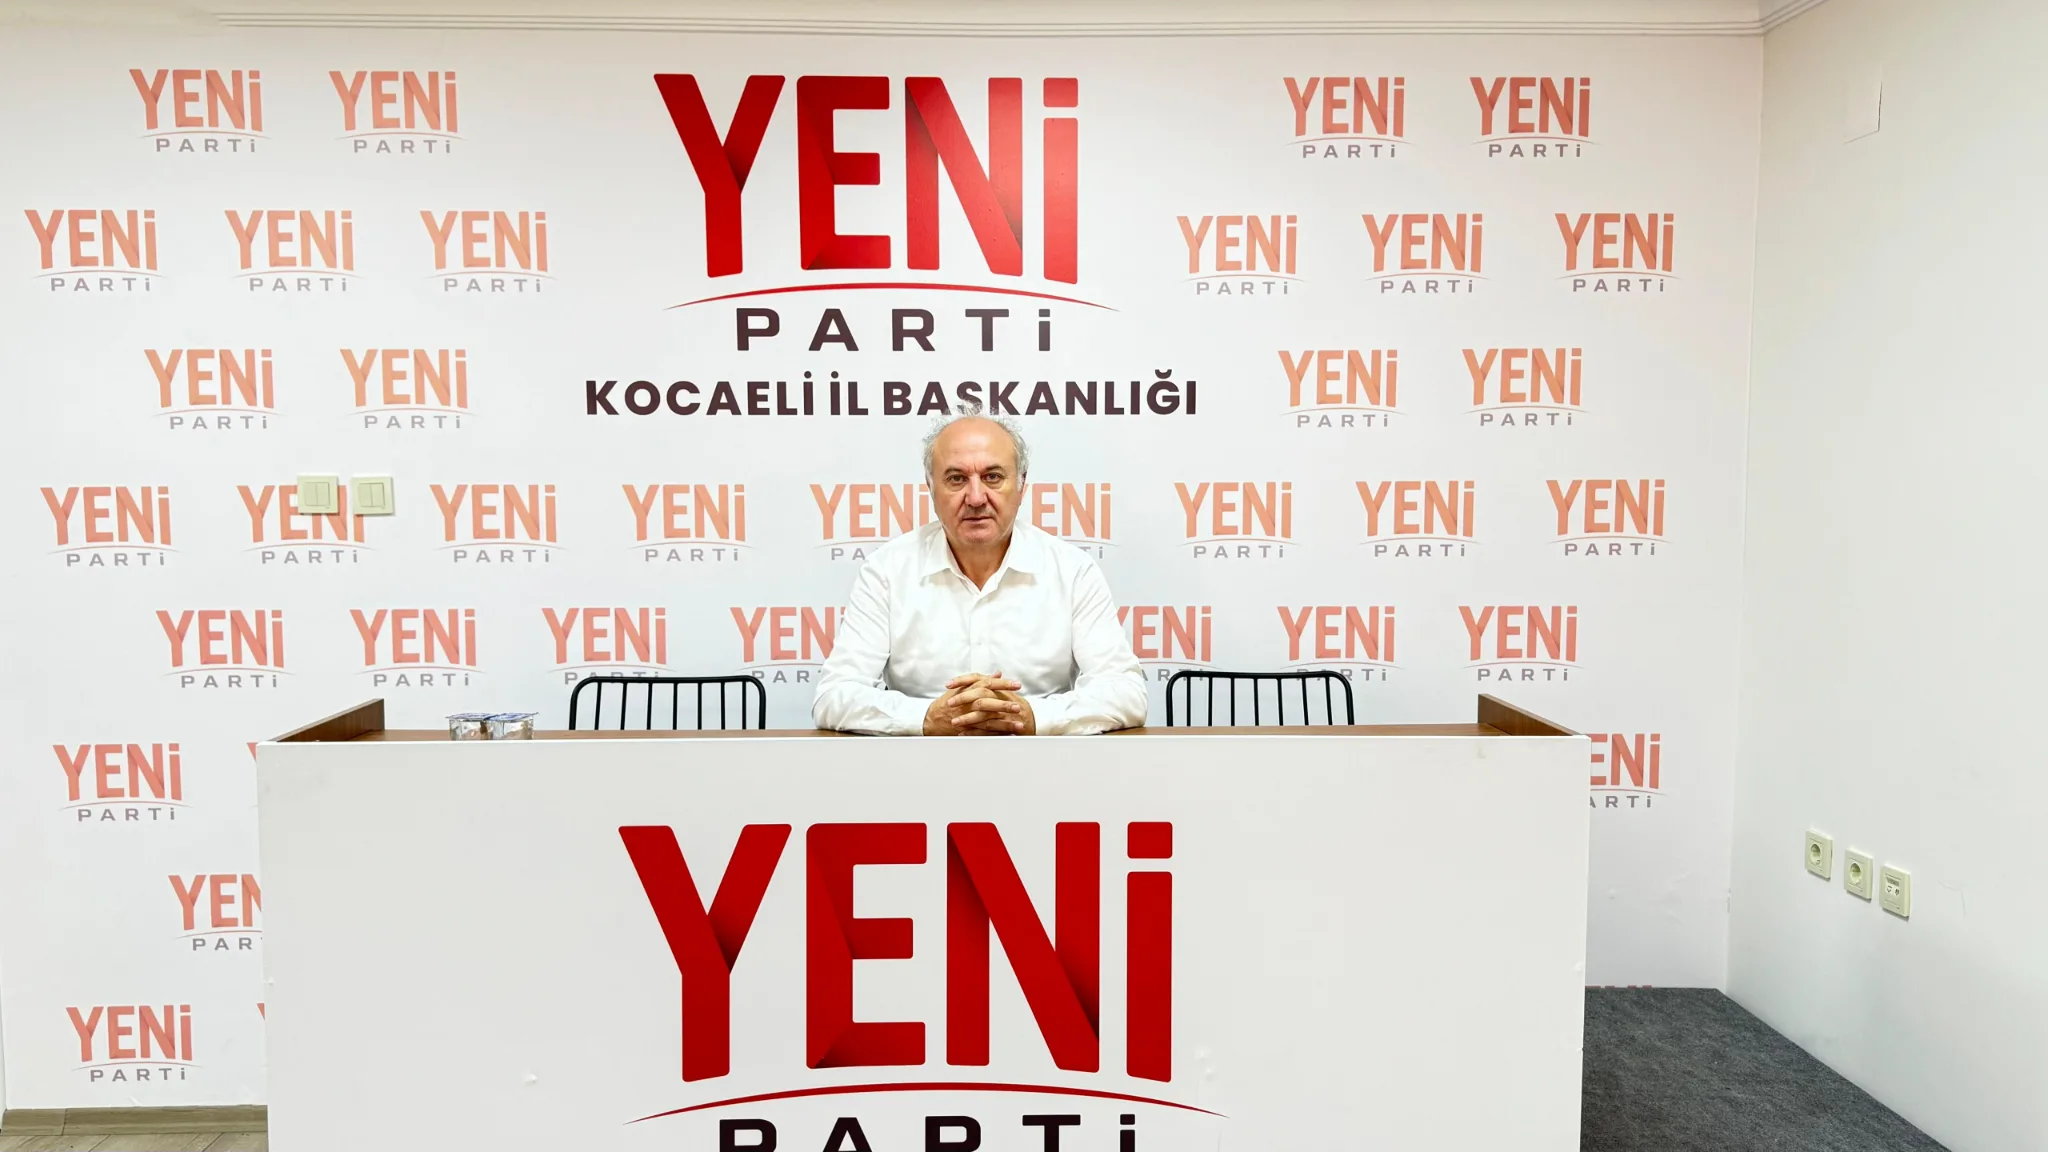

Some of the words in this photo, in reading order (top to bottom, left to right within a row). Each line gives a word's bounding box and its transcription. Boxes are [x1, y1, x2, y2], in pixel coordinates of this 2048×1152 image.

[586, 371, 814, 415] KOCAELİ
[830, 371, 868, 415] İL
[1022, 483, 1111, 540] ENi
[730, 607, 846, 662] YEN
[1117, 606, 1211, 662] ENi
[1589, 733, 1660, 788] ENi
[168, 874, 261, 930] YEN
